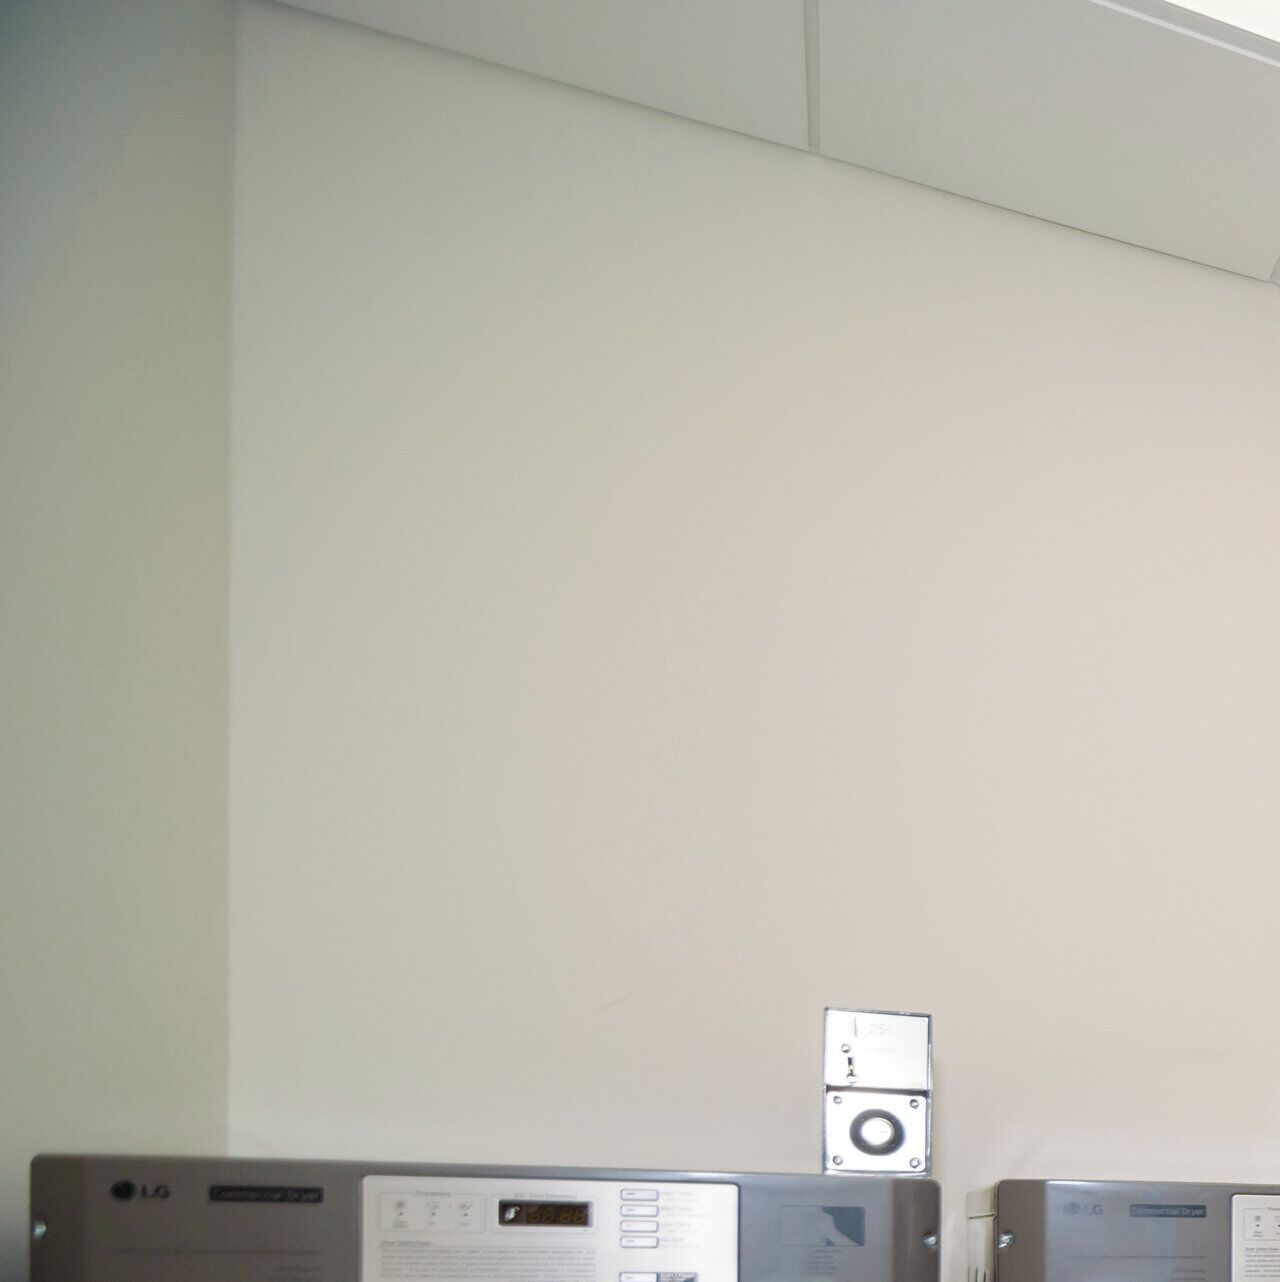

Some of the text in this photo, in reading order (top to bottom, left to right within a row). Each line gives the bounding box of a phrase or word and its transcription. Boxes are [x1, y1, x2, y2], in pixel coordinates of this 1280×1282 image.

[141, 1184, 171, 1199] LG
[1084, 1204, 1104, 1216] LG
[1131, 1206, 1204, 1217] Commercial Dryer
